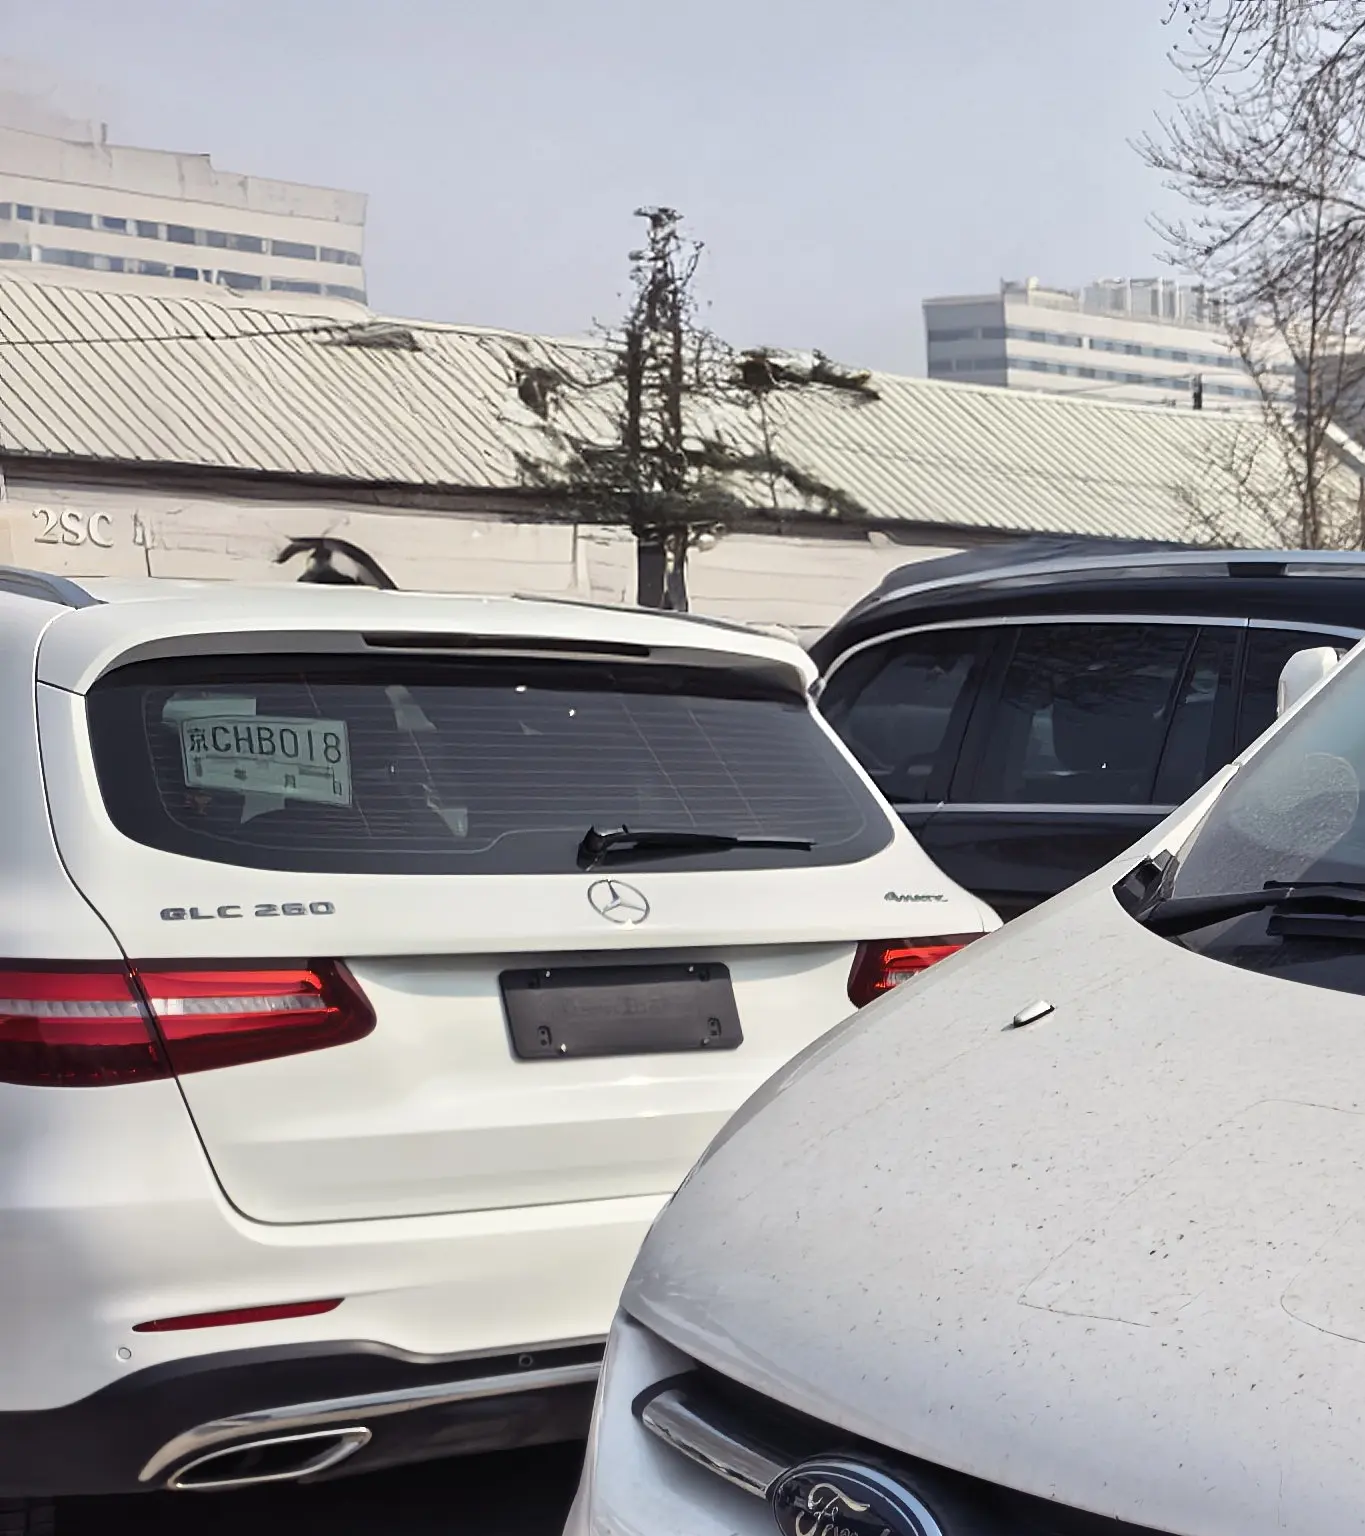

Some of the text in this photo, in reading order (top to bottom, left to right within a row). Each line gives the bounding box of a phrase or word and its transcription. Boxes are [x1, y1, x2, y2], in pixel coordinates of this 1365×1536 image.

[187, 726, 342, 764] 京CHB018
[160, 902, 336, 921] GLC 260
